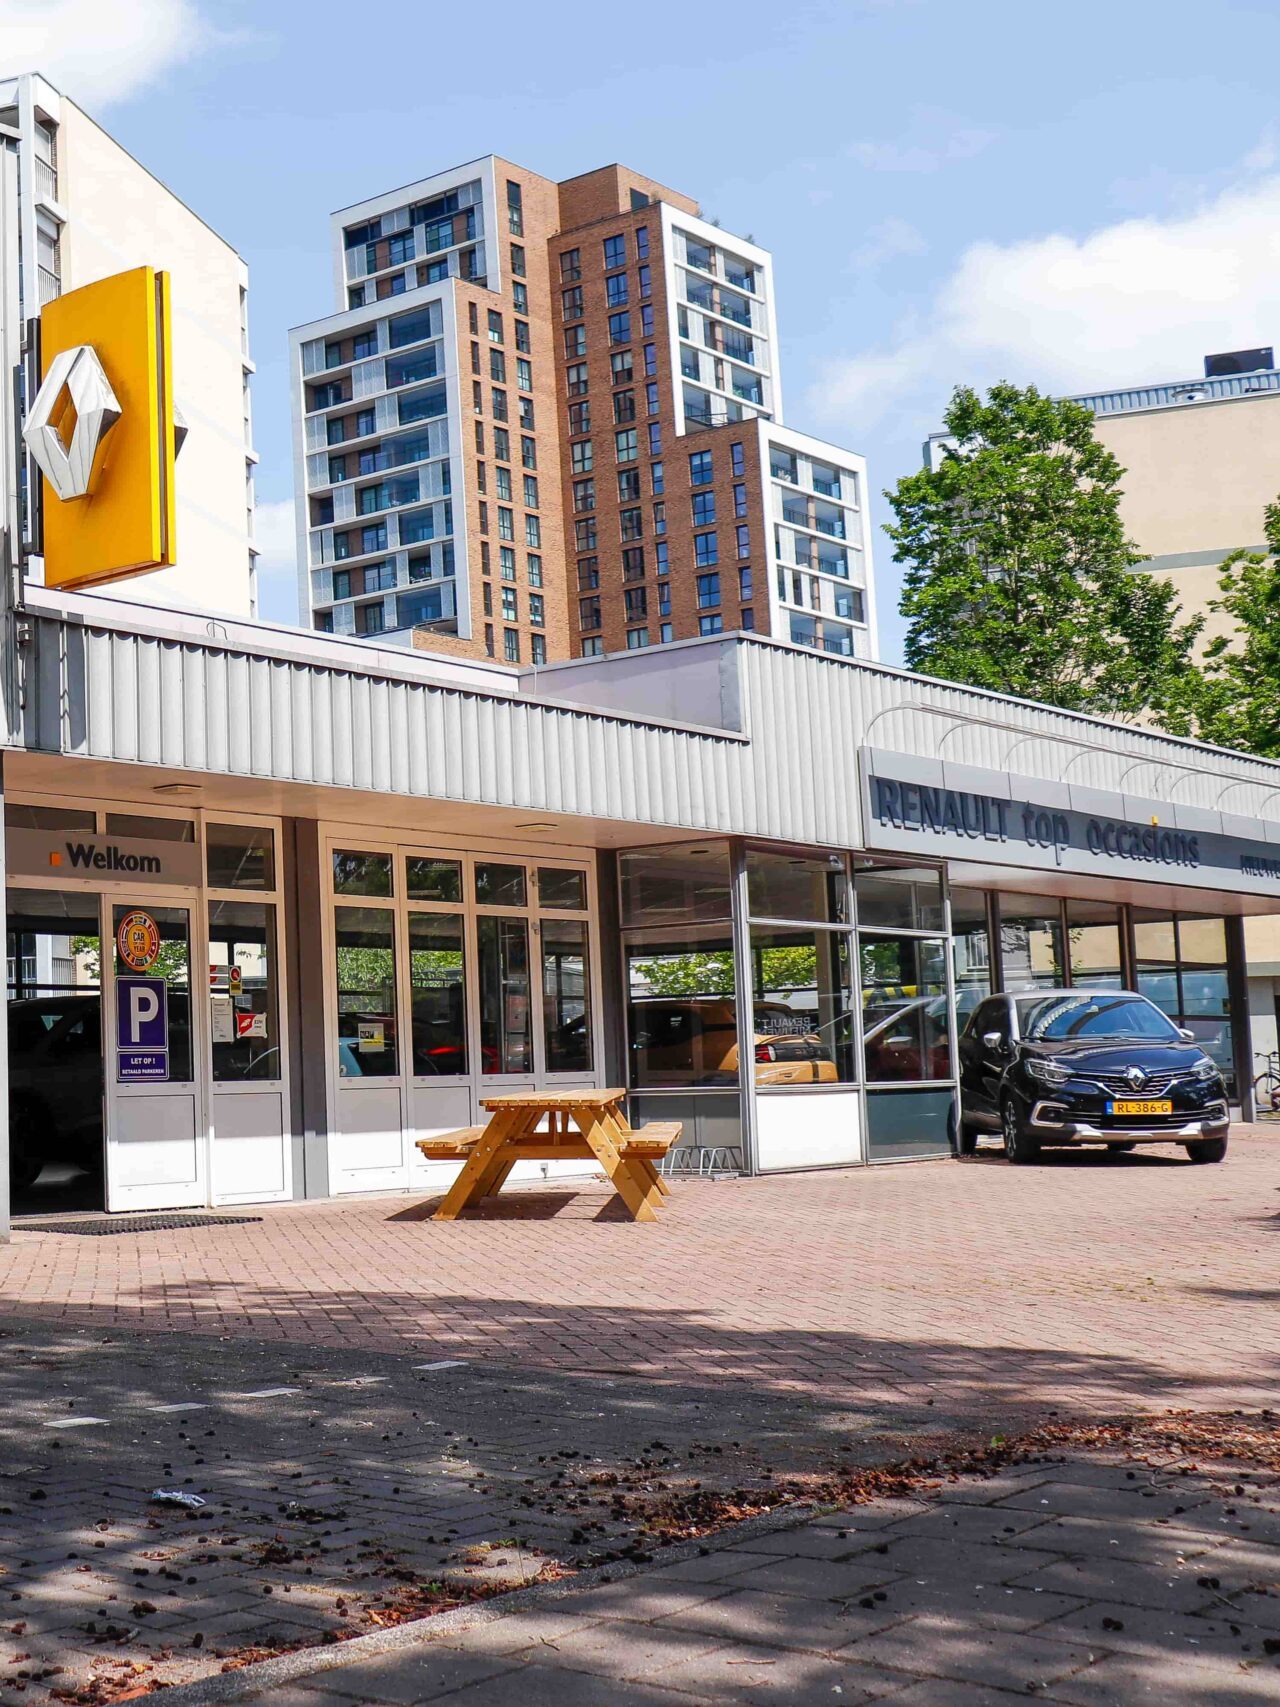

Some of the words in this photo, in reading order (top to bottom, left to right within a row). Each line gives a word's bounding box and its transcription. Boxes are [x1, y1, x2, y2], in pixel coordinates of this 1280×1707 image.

[876, 777, 1011, 843] RENAULT
[1023, 800, 1070, 866] top
[1086, 816, 1200, 868] occasions
[65, 842, 161, 873] Welkom
[133, 932, 145, 941] CAR
[129, 987, 159, 1042] P
[1117, 1103, 1168, 1113] RL-386-G
